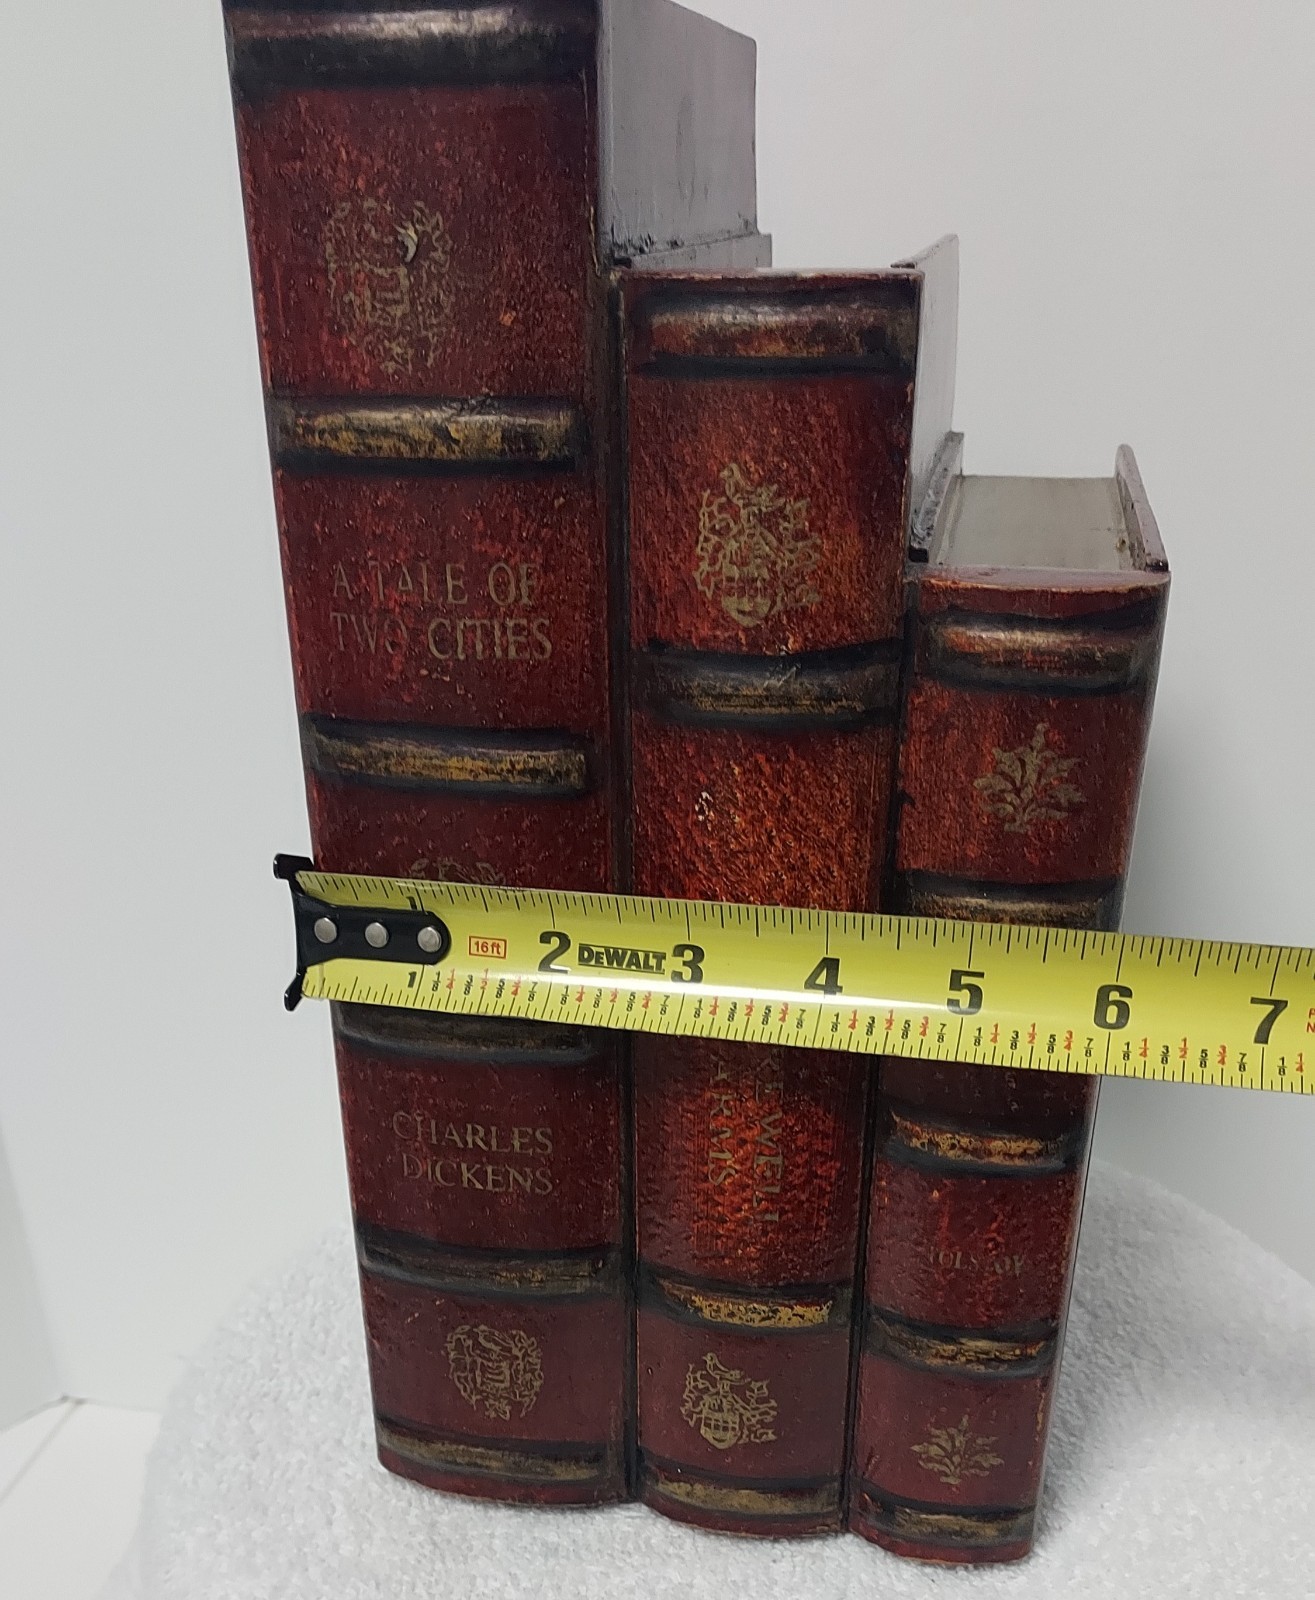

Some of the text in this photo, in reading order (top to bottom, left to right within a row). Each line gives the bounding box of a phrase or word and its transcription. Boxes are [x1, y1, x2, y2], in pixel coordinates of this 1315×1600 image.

[333, 560, 538, 606] A TALE OF
[330, 612, 552, 660] TWO CITIES
[474, 941, 501, 955] 16 ft
[538, 931, 572, 974] 2
[579, 944, 666, 973] DEWALT
[671, 944, 705, 983] 3
[408, 972, 417, 988] 1
[804, 957, 842, 996] 4
[946, 969, 985, 1016] 5
[1093, 984, 1133, 1030] 6
[1250, 997, 1288, 1045] 7
[392, 1111, 553, 1154] CHARLES
[403, 1153, 553, 1194] DICKENS
[930, 1246, 1025, 1276] TOLSOY
